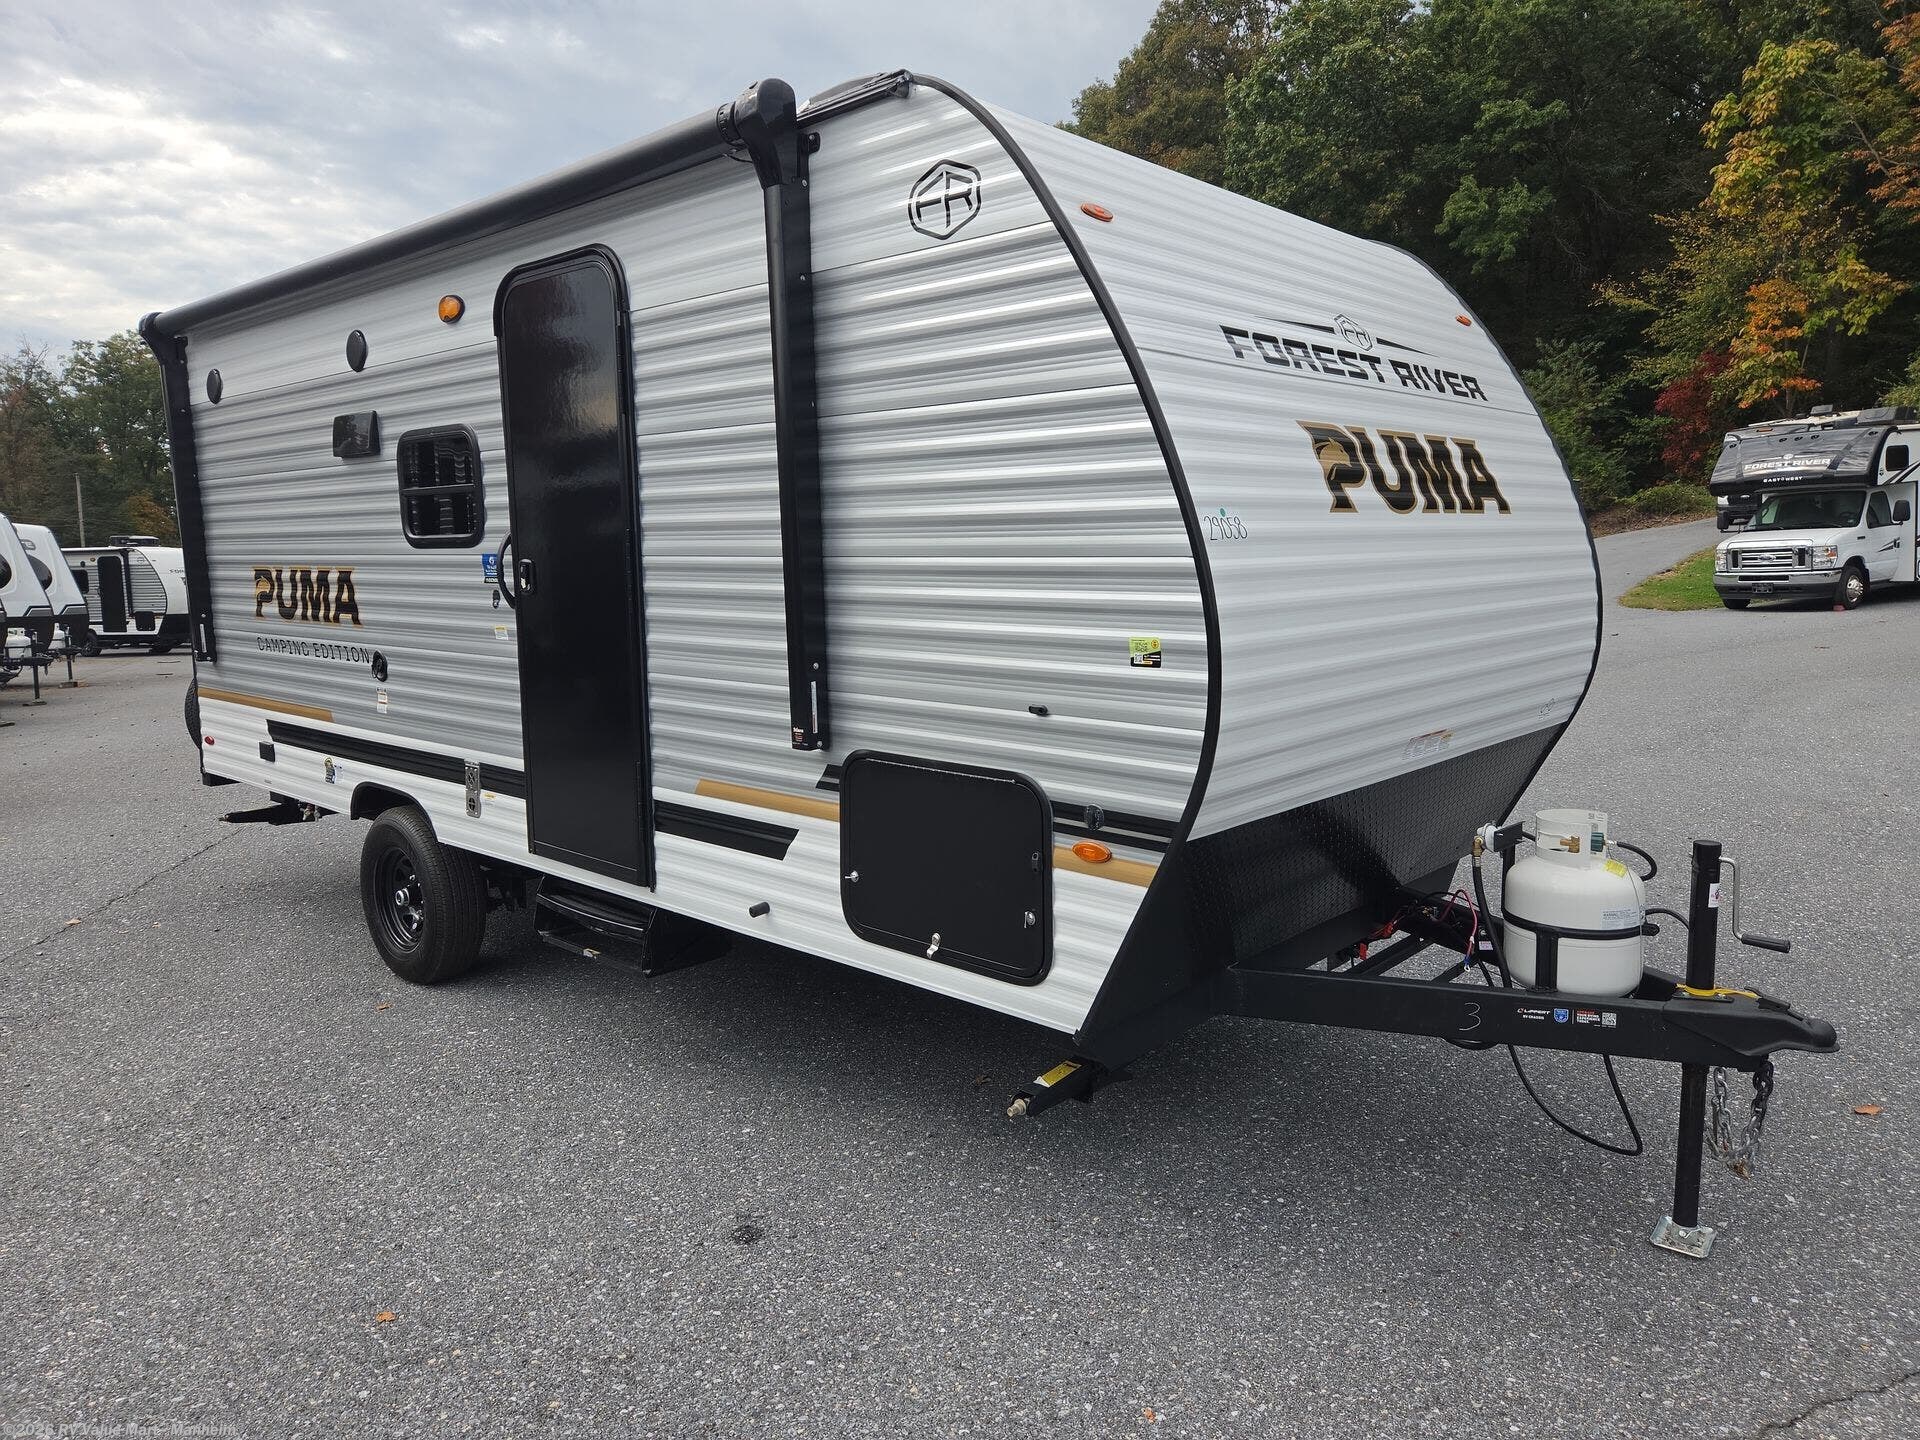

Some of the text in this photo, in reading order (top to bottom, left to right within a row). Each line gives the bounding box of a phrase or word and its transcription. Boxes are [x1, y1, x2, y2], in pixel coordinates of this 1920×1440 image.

[1219, 324, 1489, 402] FOREST RIVER
[1296, 420, 1512, 515] PUMA
[1744, 458, 1831, 470] FOREST RIVER
[1203, 514, 1249, 542] 29058
[252, 565, 364, 628] PUMA
[256, 636, 370, 664] CAMPING EDITION
[1459, 1002, 1481, 1031] 3
